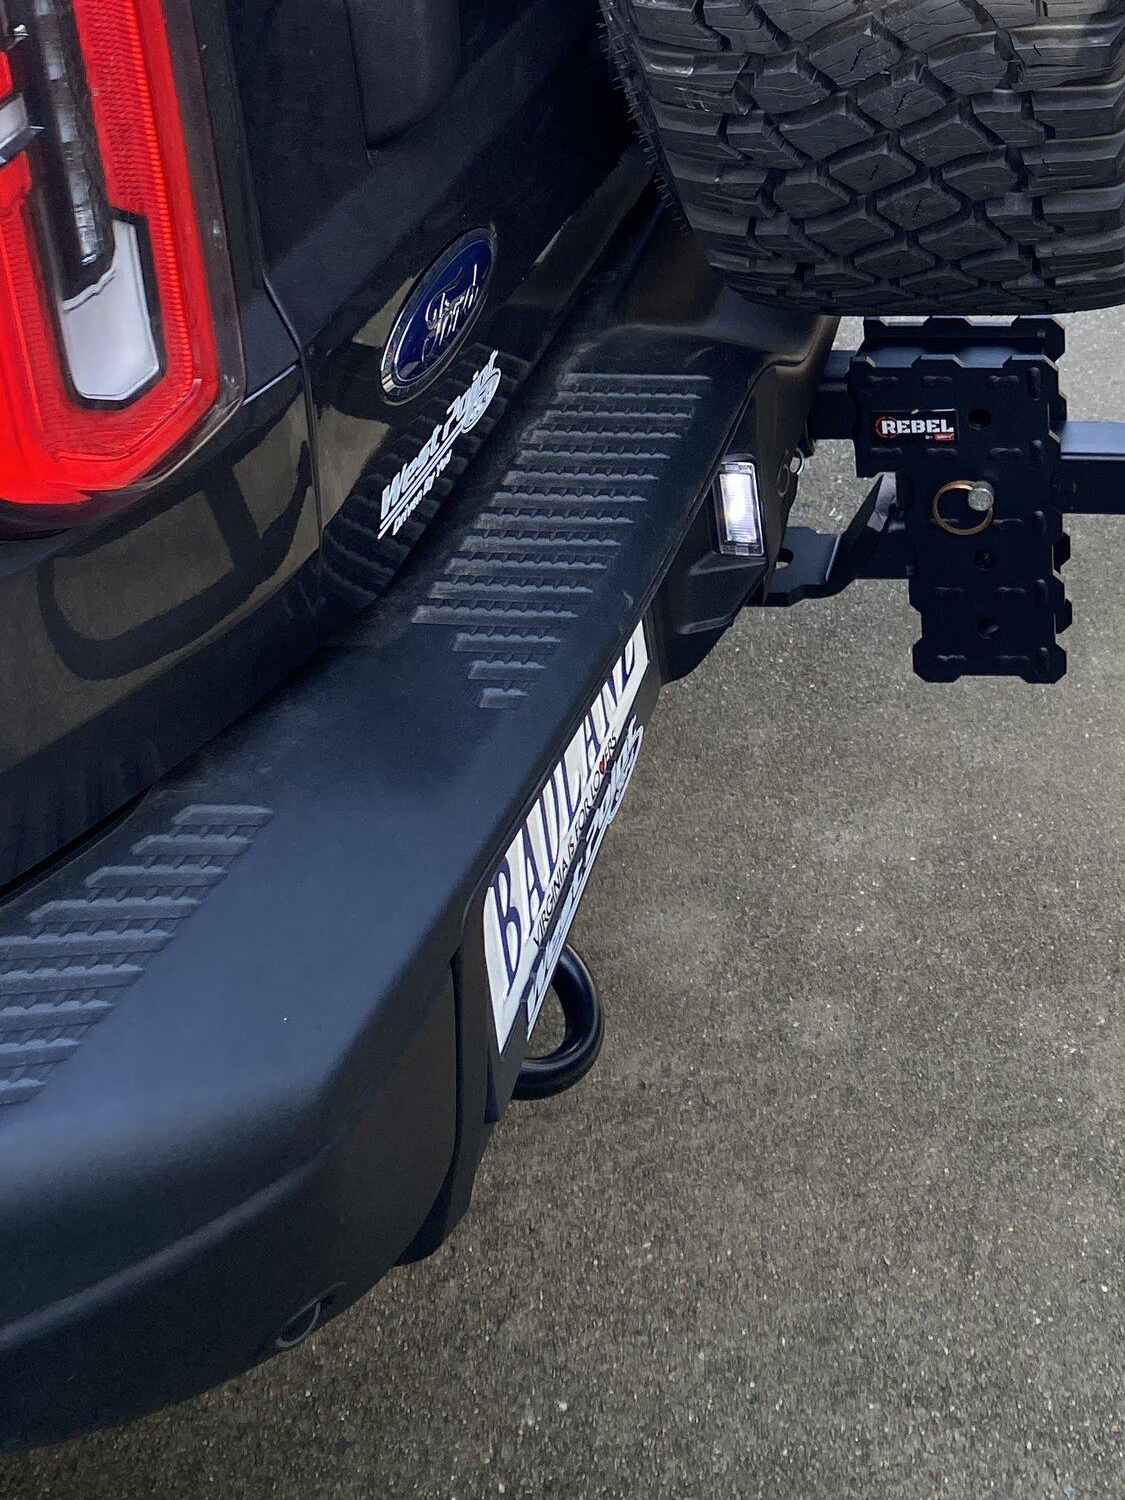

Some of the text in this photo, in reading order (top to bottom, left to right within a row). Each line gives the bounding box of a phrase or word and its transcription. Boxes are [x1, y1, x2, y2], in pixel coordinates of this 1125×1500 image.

[422, 263, 480, 362] Ford
[380, 424, 442, 520] West
[881, 419, 954, 434] REBEL
[533, 856, 569, 948] VIRGINIA
[567, 840, 577, 861] IS
[574, 798, 592, 835] FOR
